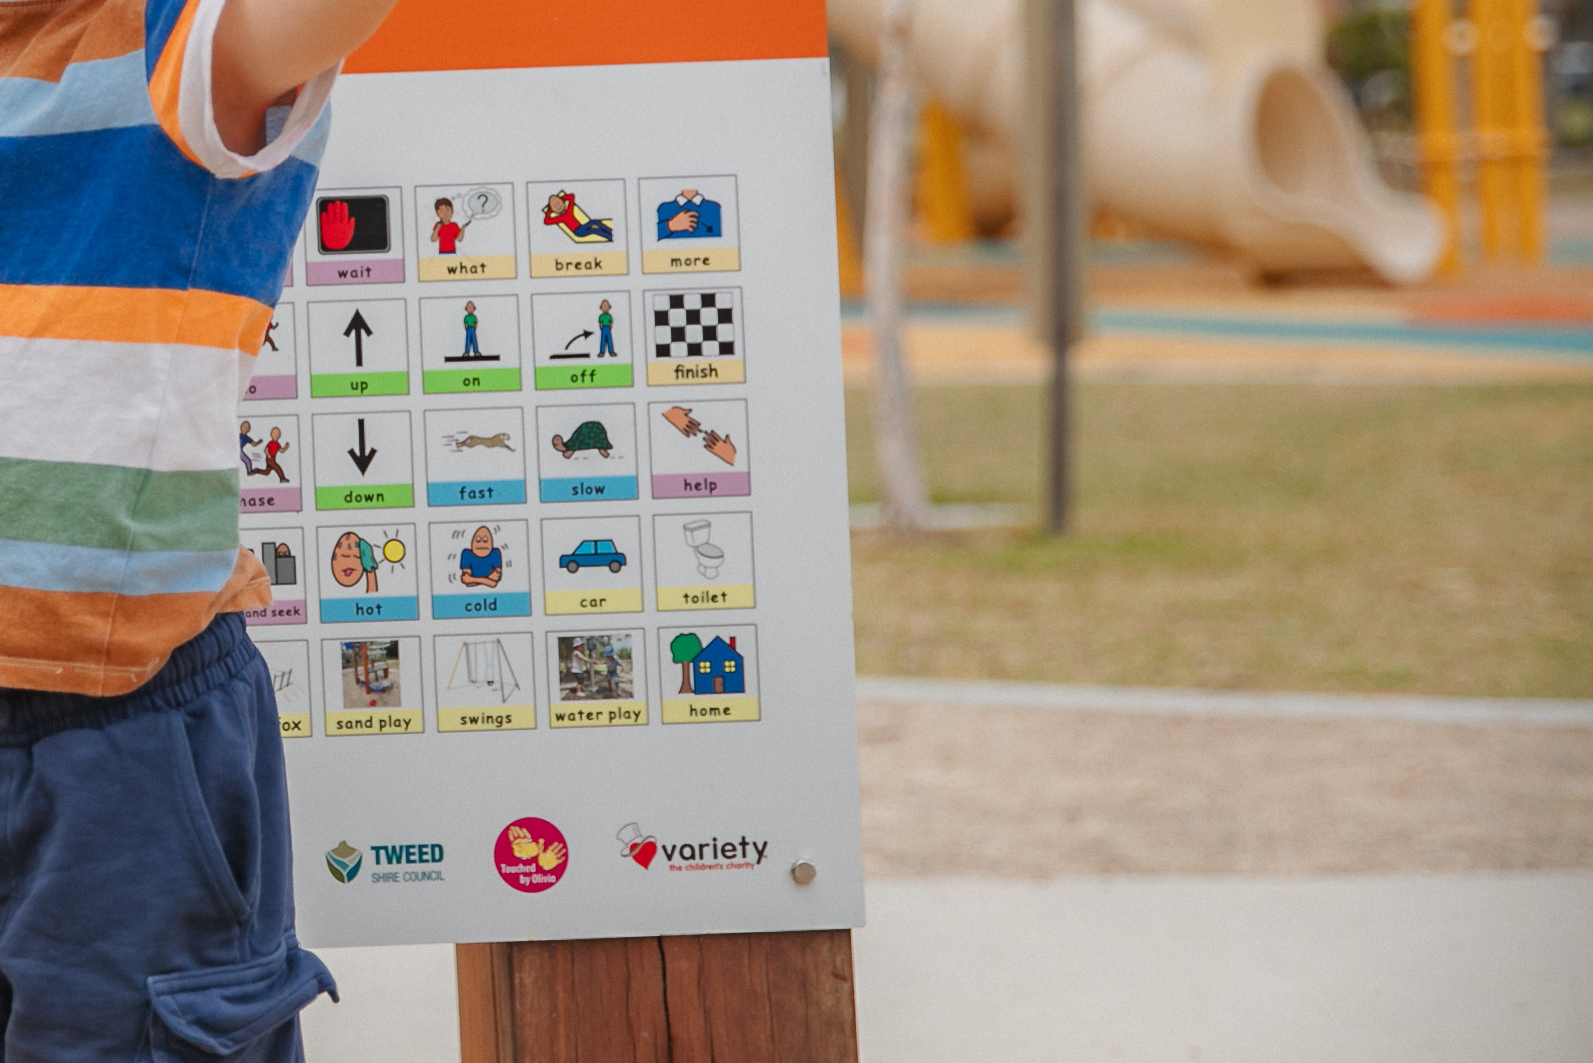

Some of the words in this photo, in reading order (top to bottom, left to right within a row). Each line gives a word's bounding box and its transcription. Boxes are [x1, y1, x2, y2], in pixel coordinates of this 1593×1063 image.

[447, 262, 487, 275] what
[554, 257, 603, 272] break
[670, 255, 711, 268] more
[337, 266, 372, 279] wait
[570, 369, 597, 383] off
[674, 364, 719, 379] finish
[350, 379, 369, 393] up
[462, 376, 481, 387] on
[459, 486, 494, 500] fast
[571, 482, 606, 496] slow
[683, 479, 718, 494] help
[344, 490, 385, 504] down
[580, 597, 607, 608] car
[683, 591, 728, 604] toilet
[245, 607, 267, 618] and
[271, 605, 301, 618] seek
[355, 602, 383, 616] hot
[464, 598, 497, 612] cold
[555, 709, 604, 723] water
[608, 706, 642, 724] play
[688, 704, 732, 717] home
[336, 716, 373, 730] sand
[378, 714, 412, 732] play
[459, 712, 513, 728] swings
[370, 843, 444, 866] TWEED
[661, 835, 769, 865] variety
[371, 871, 401, 884] SHIRE
[403, 870, 446, 883] COUNCIL
